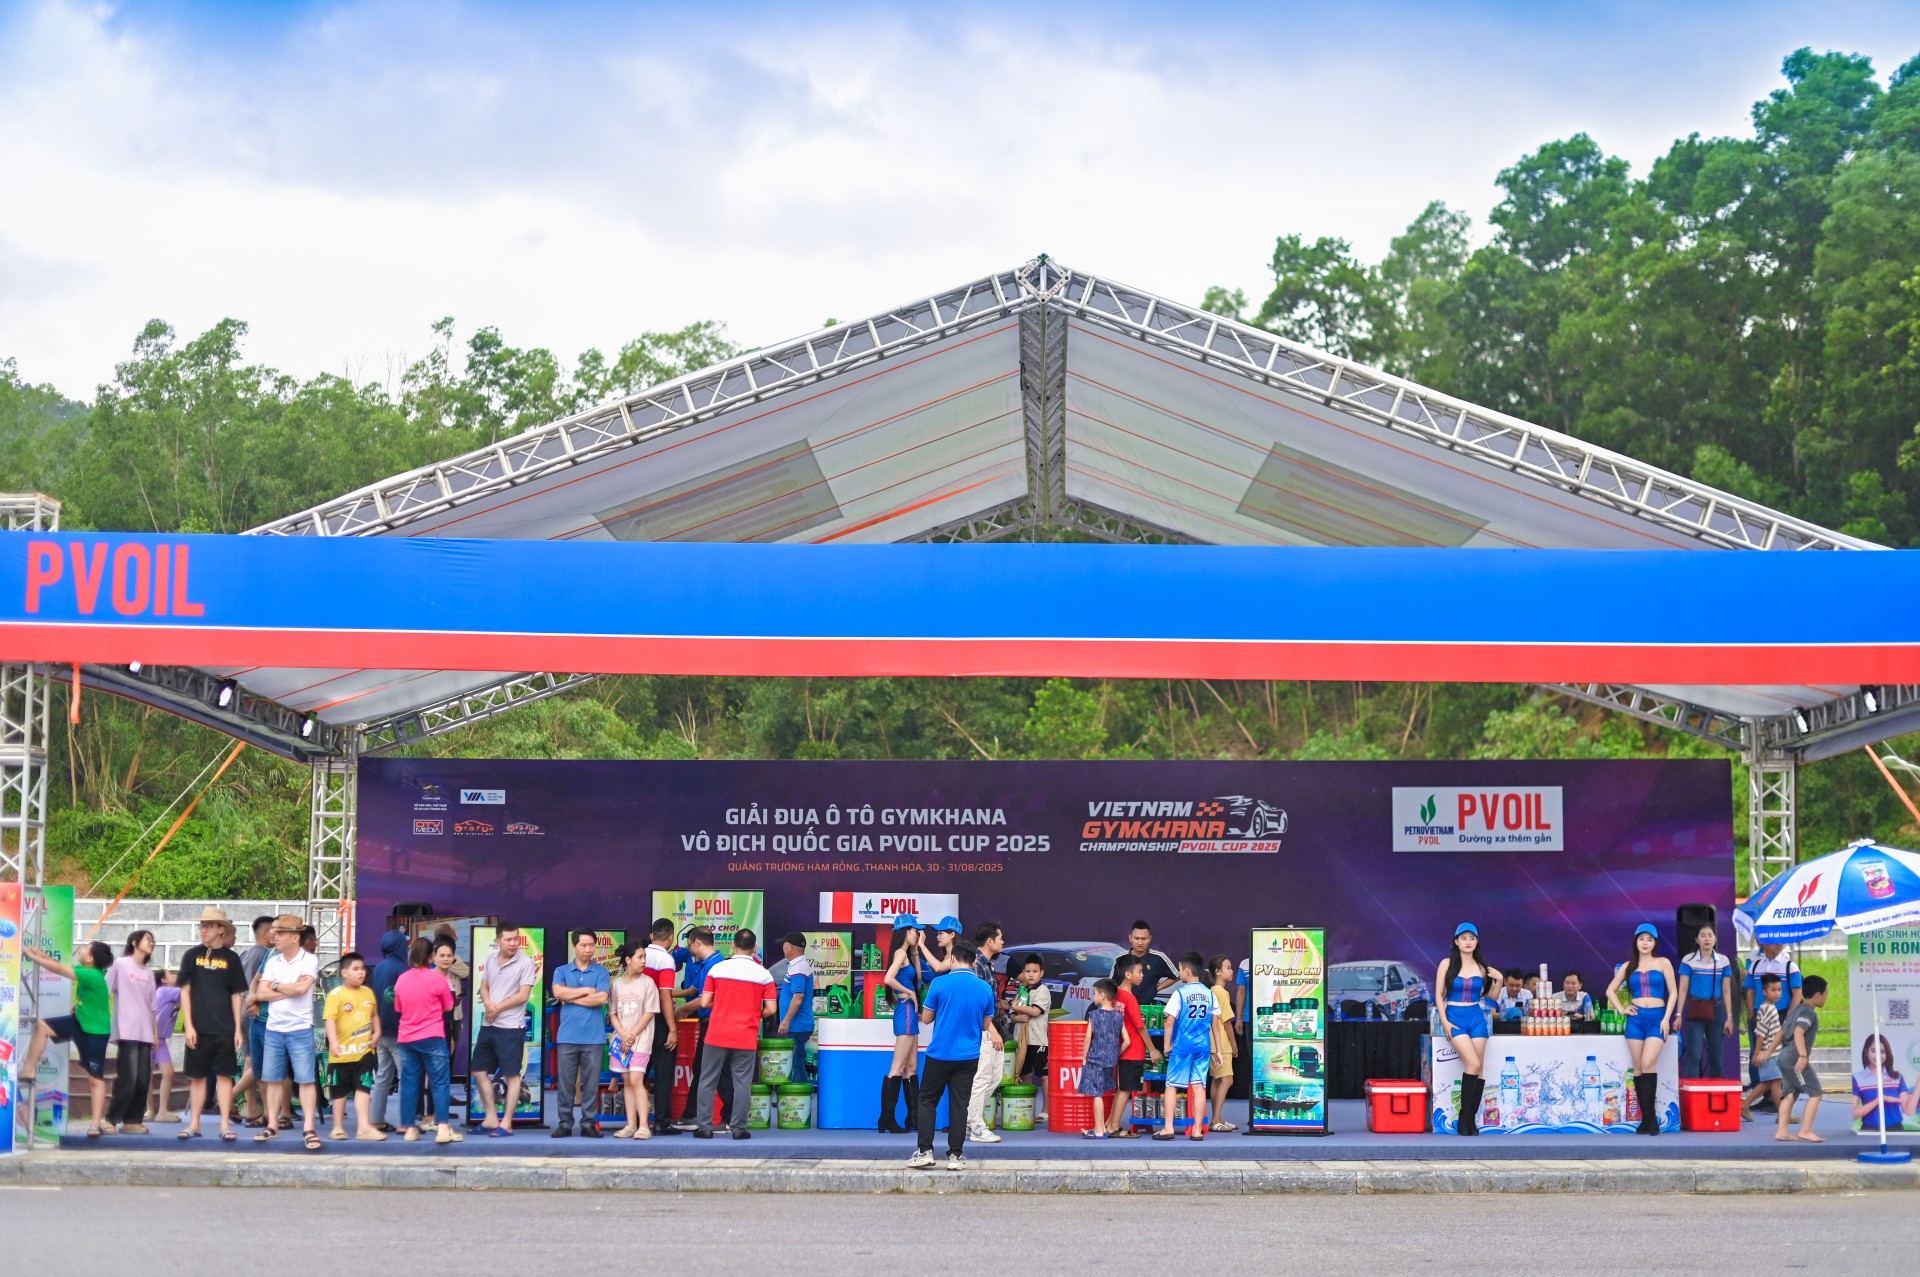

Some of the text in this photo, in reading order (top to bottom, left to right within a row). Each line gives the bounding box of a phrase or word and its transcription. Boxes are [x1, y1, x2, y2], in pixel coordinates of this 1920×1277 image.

[25, 541, 204, 616] PVOIL
[725, 802, 1007, 825] GIẢI ĐUA Ô TÔ GYMKHANA
[1088, 801, 1193, 817] VIETNAM
[1458, 793, 1551, 830] PVOIL
[1081, 821, 1226, 839] GYMKHANA
[1404, 825, 1454, 835] PETROVIETNAM
[681, 827, 1050, 856] VÔ ĐỊCH QUỐC GIA PVOIL CUP 2025
[1418, 836, 1440, 845] PVOIL
[1459, 834, 1492, 844] Đường
[1508, 834, 1531, 843] thêm
[1534, 833, 1552, 844] gần
[1079, 842, 1278, 852] CHAMPIONSHIP PVOIL CUP 2025
[728, 861, 762, 872] QUẢNG
[807, 861, 830, 871] HÀM
[927, 863, 939, 872] 30
[948, 862, 1003, 872] 31/08/2025
[694, 899, 734, 915] PVOIL
[881, 898, 919, 914] PVOIL
[1772, 903, 1828, 919] PETROVIETNAM
[700, 922, 740, 931] RÒ CHƠI
[1887, 930, 1908, 939] SINH
[597, 937, 613, 946] VOIL
[821, 938, 840, 947] PVOIL
[1282, 938, 1308, 949] PVOIL
[1860, 942, 1887, 954] E10
[813, 960, 836, 969] Engine
[1254, 964, 1321, 977] PV Engine RMI
[1070, 986, 1091, 1000] PVOIL
[1186, 993, 1210, 1004] BASKETBALL
[1188, 1004, 1207, 1019] 23
